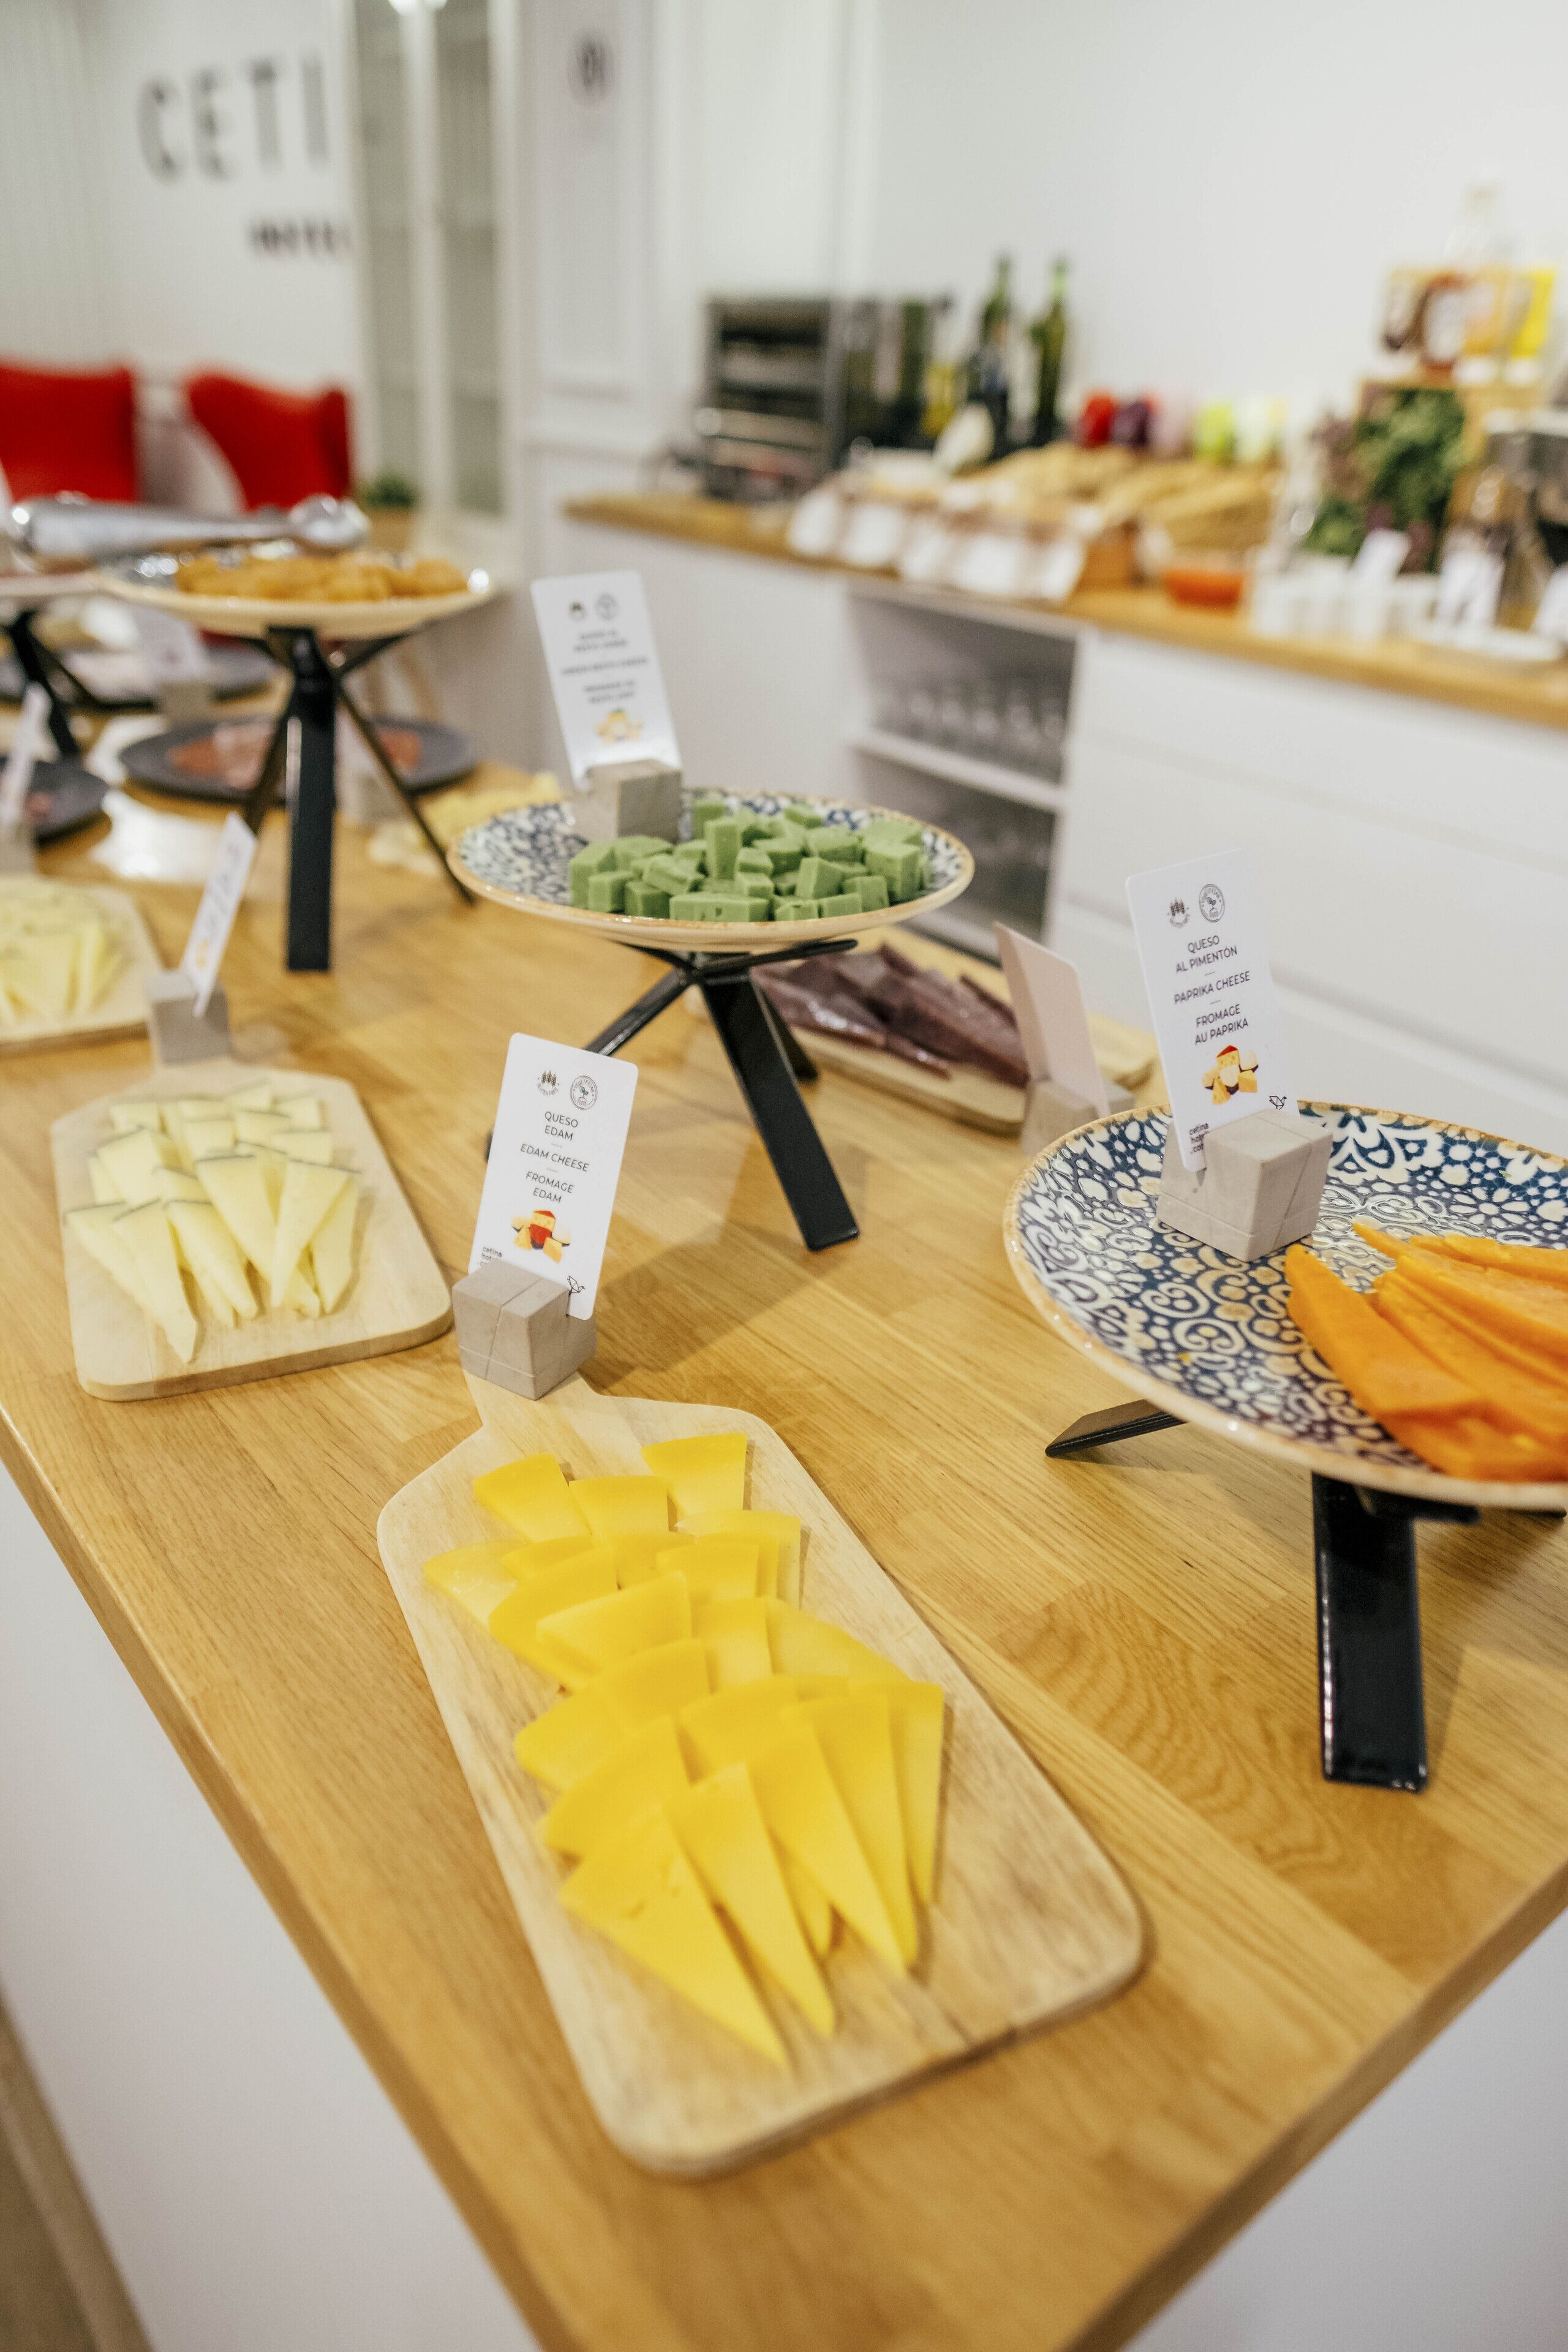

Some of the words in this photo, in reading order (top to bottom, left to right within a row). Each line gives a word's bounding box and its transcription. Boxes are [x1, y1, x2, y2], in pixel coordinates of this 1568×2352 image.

[1188, 935, 1219, 954] QUESO
[1175, 961, 1188, 974] AL
[1189, 945, 1238, 969] PIMENTÓN
[1174, 983, 1214, 1005] PAPRIKA
[1216, 971, 1250, 990] CHEESE
[1196, 1004, 1241, 1028] FROMAGE
[1194, 1031, 1208, 1046] AU
[1210, 1017, 1249, 1039] PAPRIKA
[545, 1111, 578, 1128] QUESO
[545, 1125, 573, 1141] EDAM
[520, 1143, 549, 1159] EDAM
[551, 1153, 589, 1172] CHEESE
[526, 1171, 575, 1194] FROMAGE
[533, 1188, 562, 1204] EDAM
